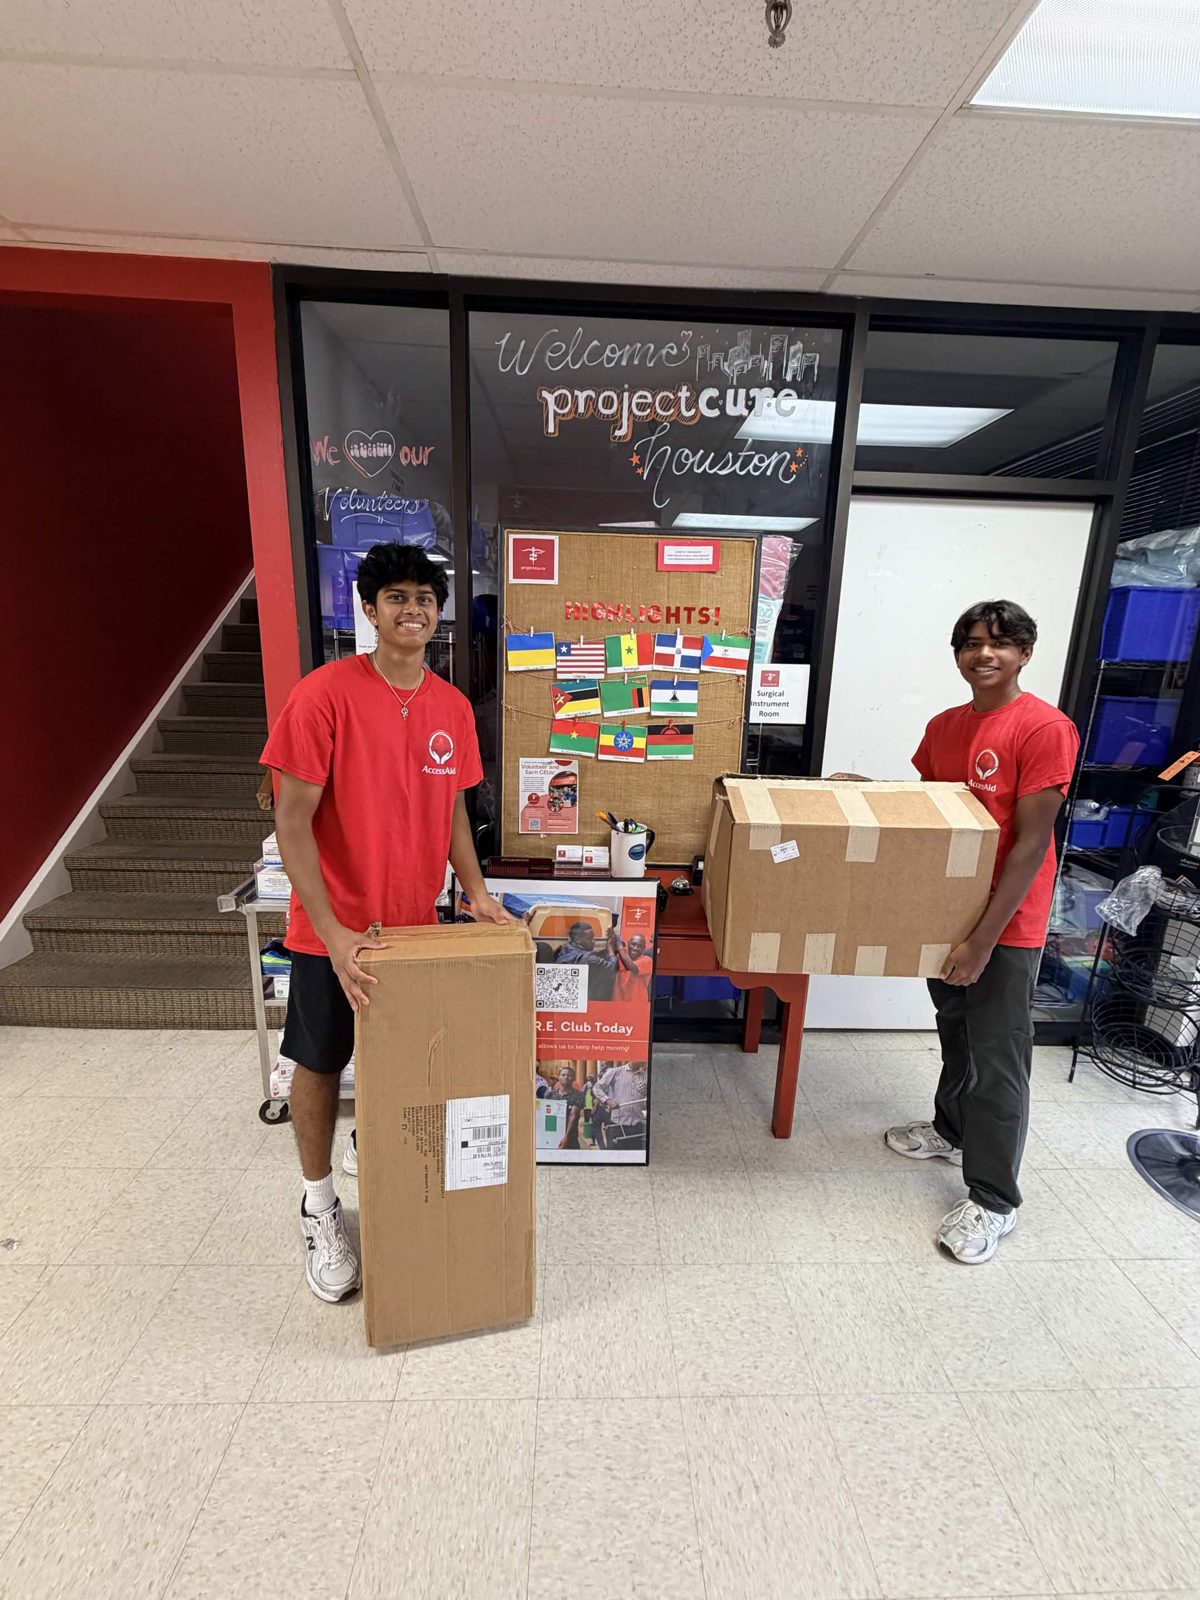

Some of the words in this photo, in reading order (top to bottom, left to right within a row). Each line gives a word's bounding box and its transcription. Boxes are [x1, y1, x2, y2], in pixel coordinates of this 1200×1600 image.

[495, 327, 691, 376] Welcome
[311, 435, 341, 467] We
[399, 445, 436, 467] our
[634, 422, 797, 508] houston
[318, 487, 424, 522] Volunteers
[565, 600, 721, 626] HIGHLIGHTS!
[756, 689, 785, 698] Surgical
[421, 764, 456, 775] AccessAid
[560, 1021, 591, 1033] Club
[594, 1022, 634, 1037] Today
[605, 1045, 630, 1053] moving!
